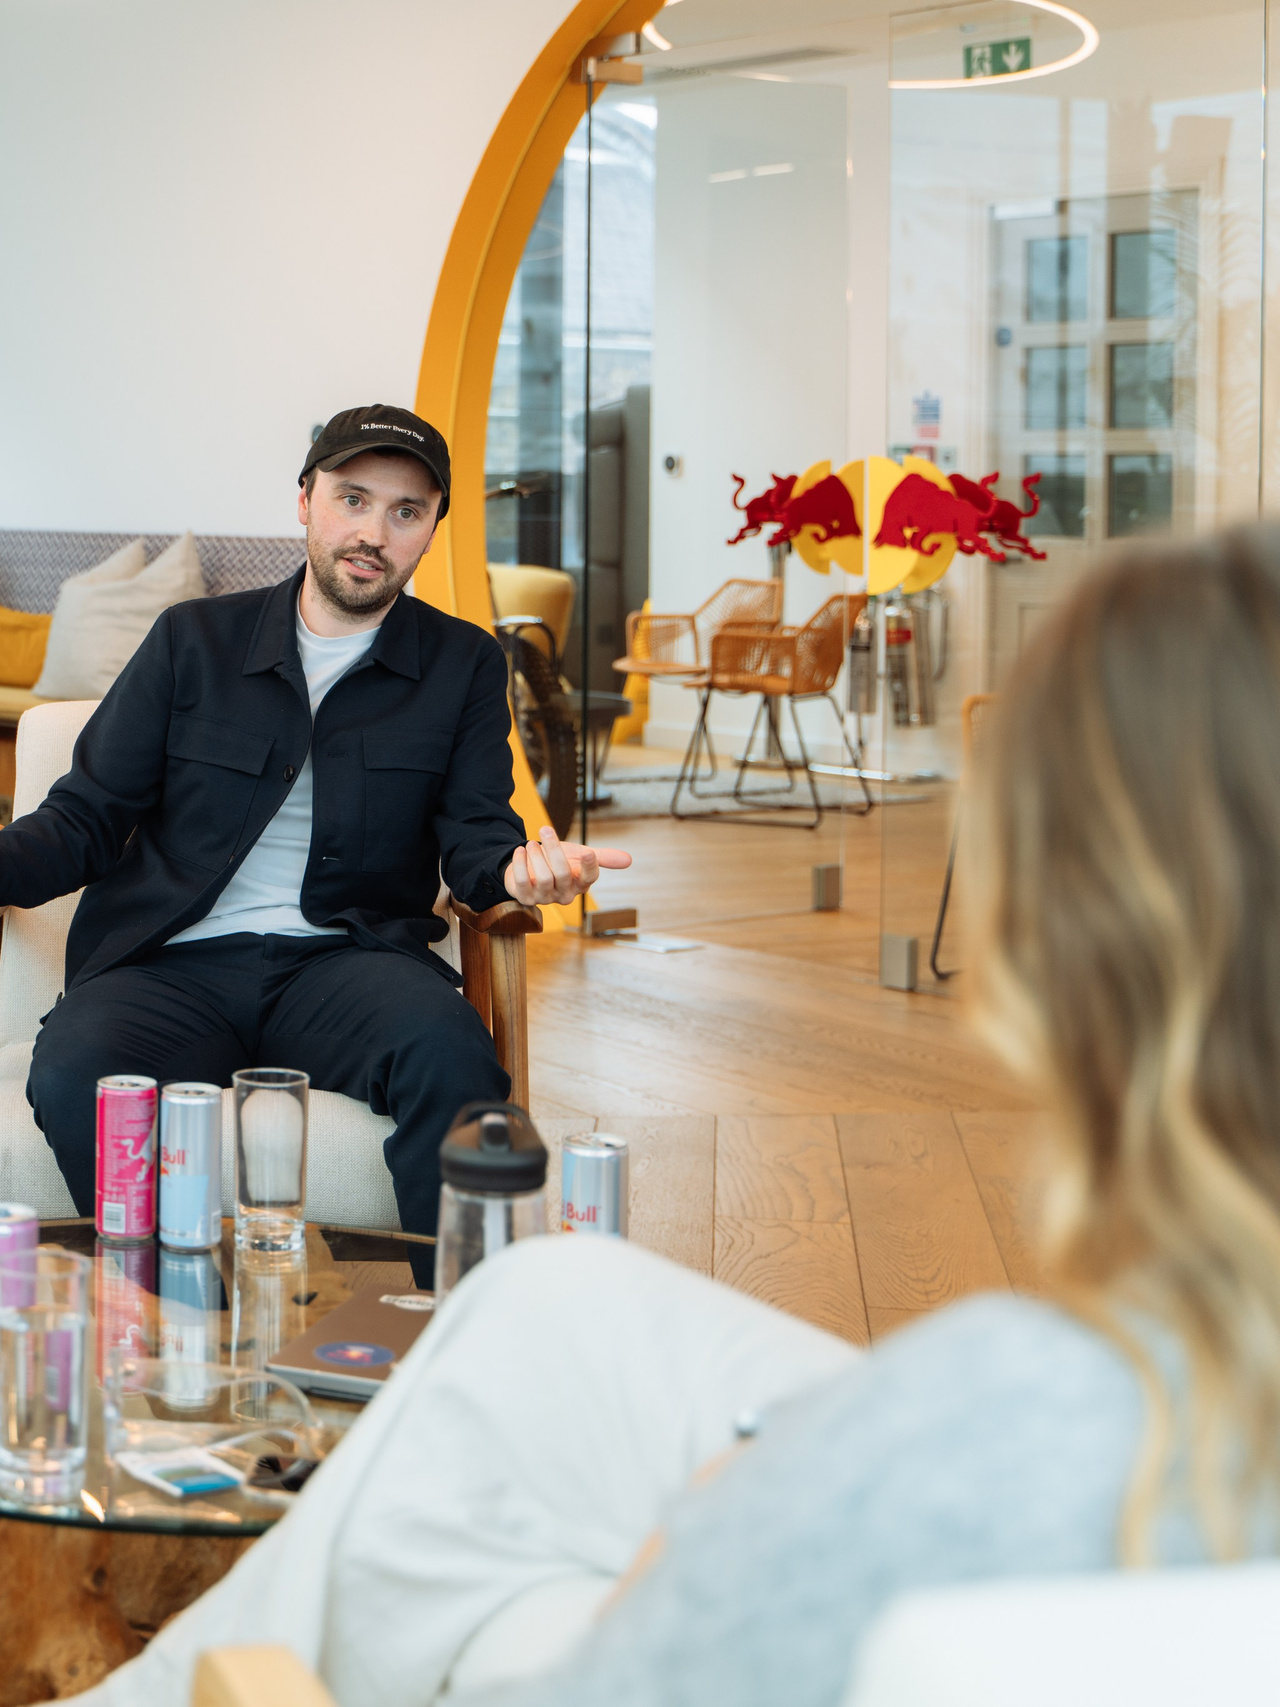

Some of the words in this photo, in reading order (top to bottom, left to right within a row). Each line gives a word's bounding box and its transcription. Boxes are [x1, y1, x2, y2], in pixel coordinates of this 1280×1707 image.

[393, 425, 412, 435] Every
[413, 431, 424, 442] Day.
[161, 1146, 186, 1166] Bull
[566, 1202, 597, 1223] Bull
